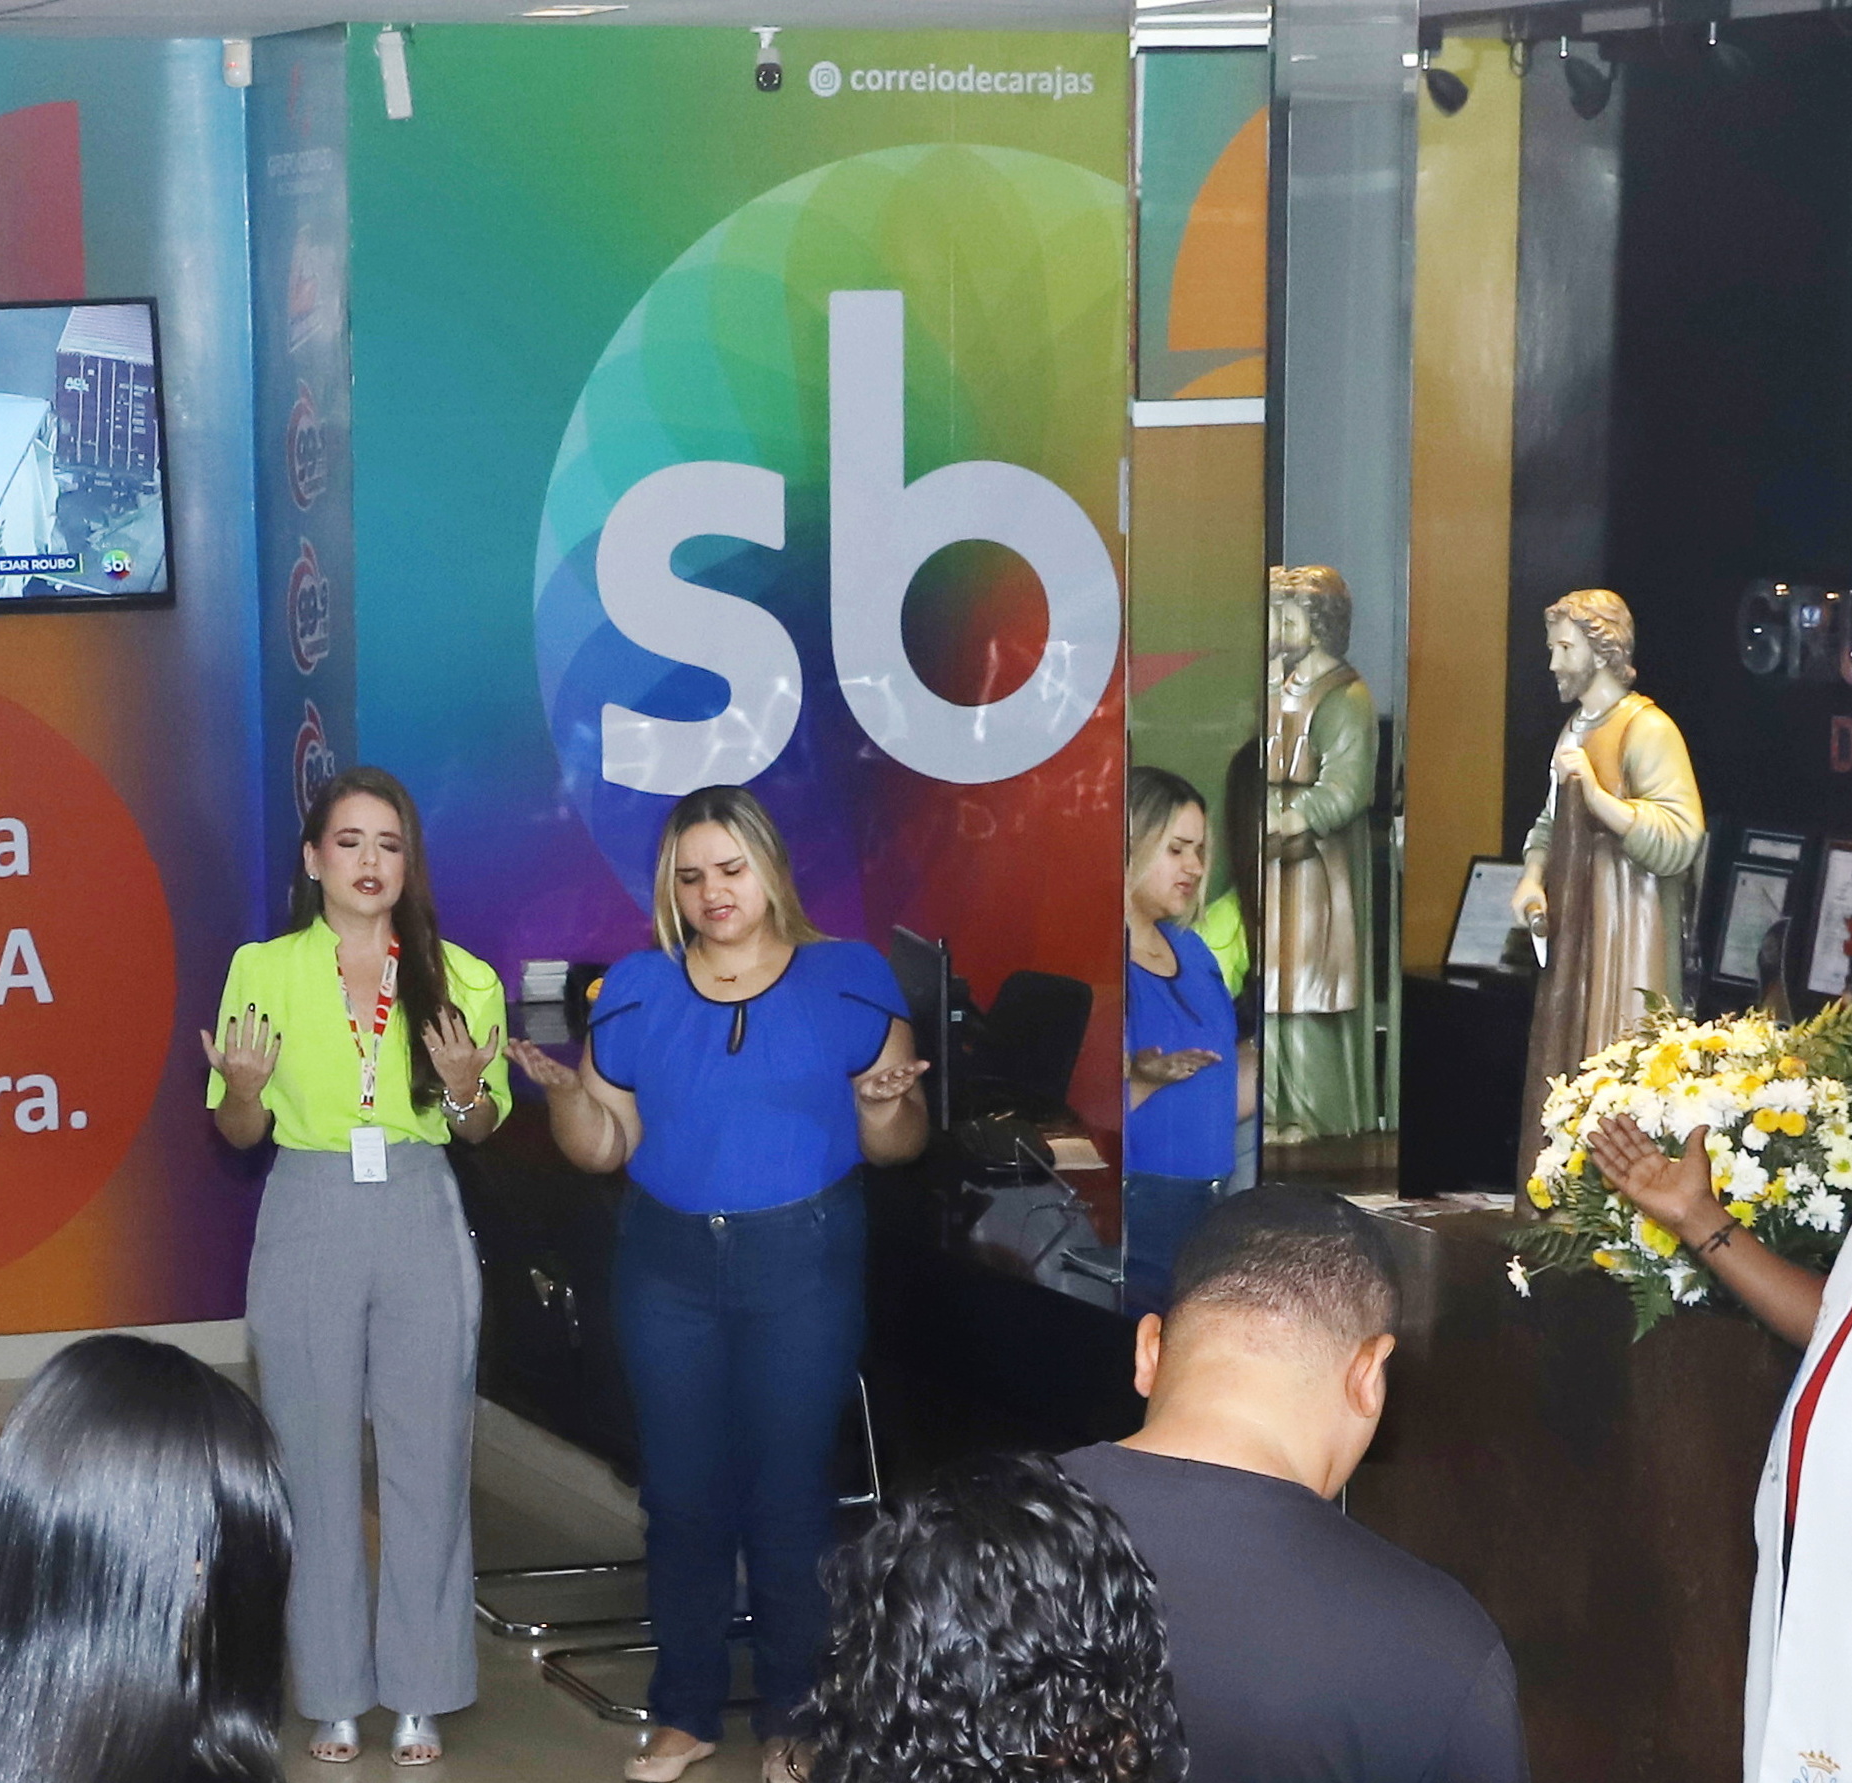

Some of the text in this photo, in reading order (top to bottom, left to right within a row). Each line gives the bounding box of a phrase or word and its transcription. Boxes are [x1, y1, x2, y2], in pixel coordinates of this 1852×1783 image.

[850, 64, 1095, 100] correiodecarajas
[31, 558, 76, 570] ROUBO
[103, 557, 132, 573] sbt
